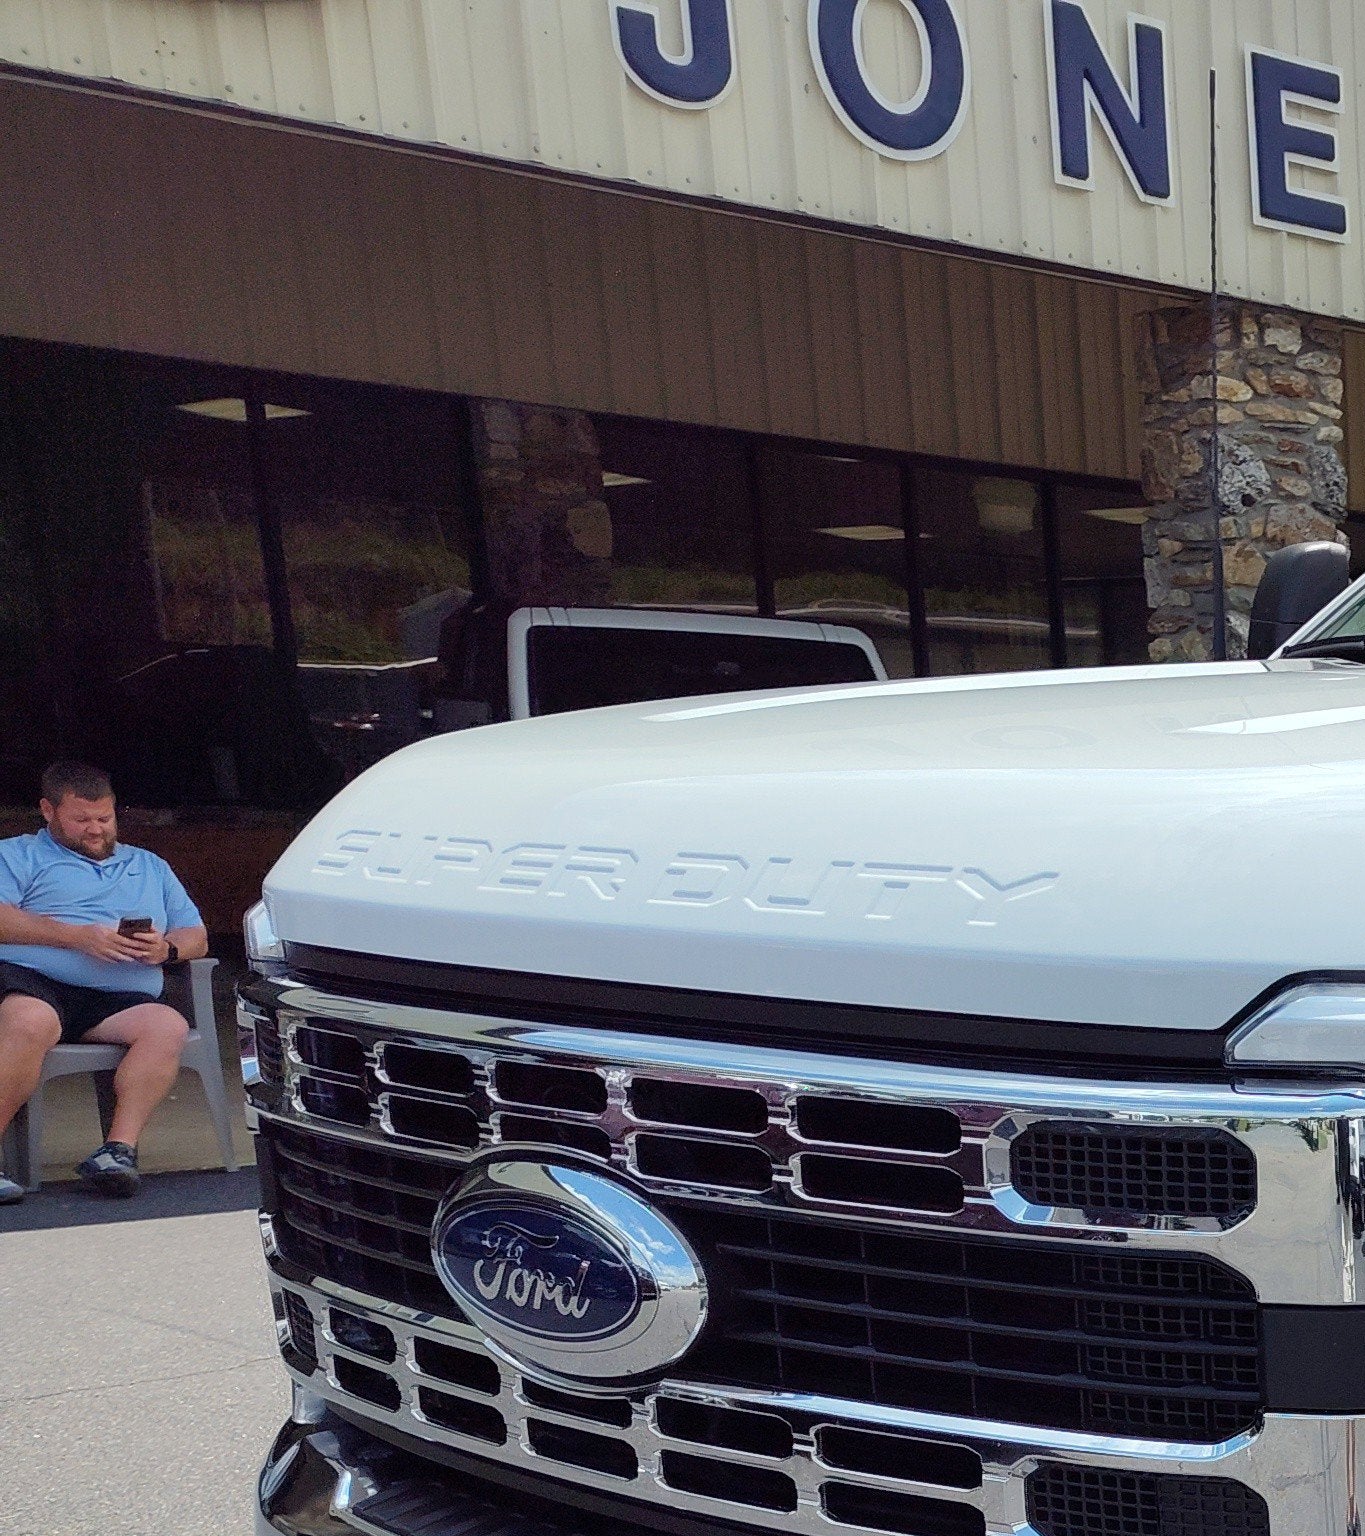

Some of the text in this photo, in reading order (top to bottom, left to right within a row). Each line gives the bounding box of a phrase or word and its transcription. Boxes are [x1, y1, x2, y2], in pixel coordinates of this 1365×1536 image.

[312, 829, 1061, 926] SUPER DUTY
[473, 1220, 591, 1319] Ford
